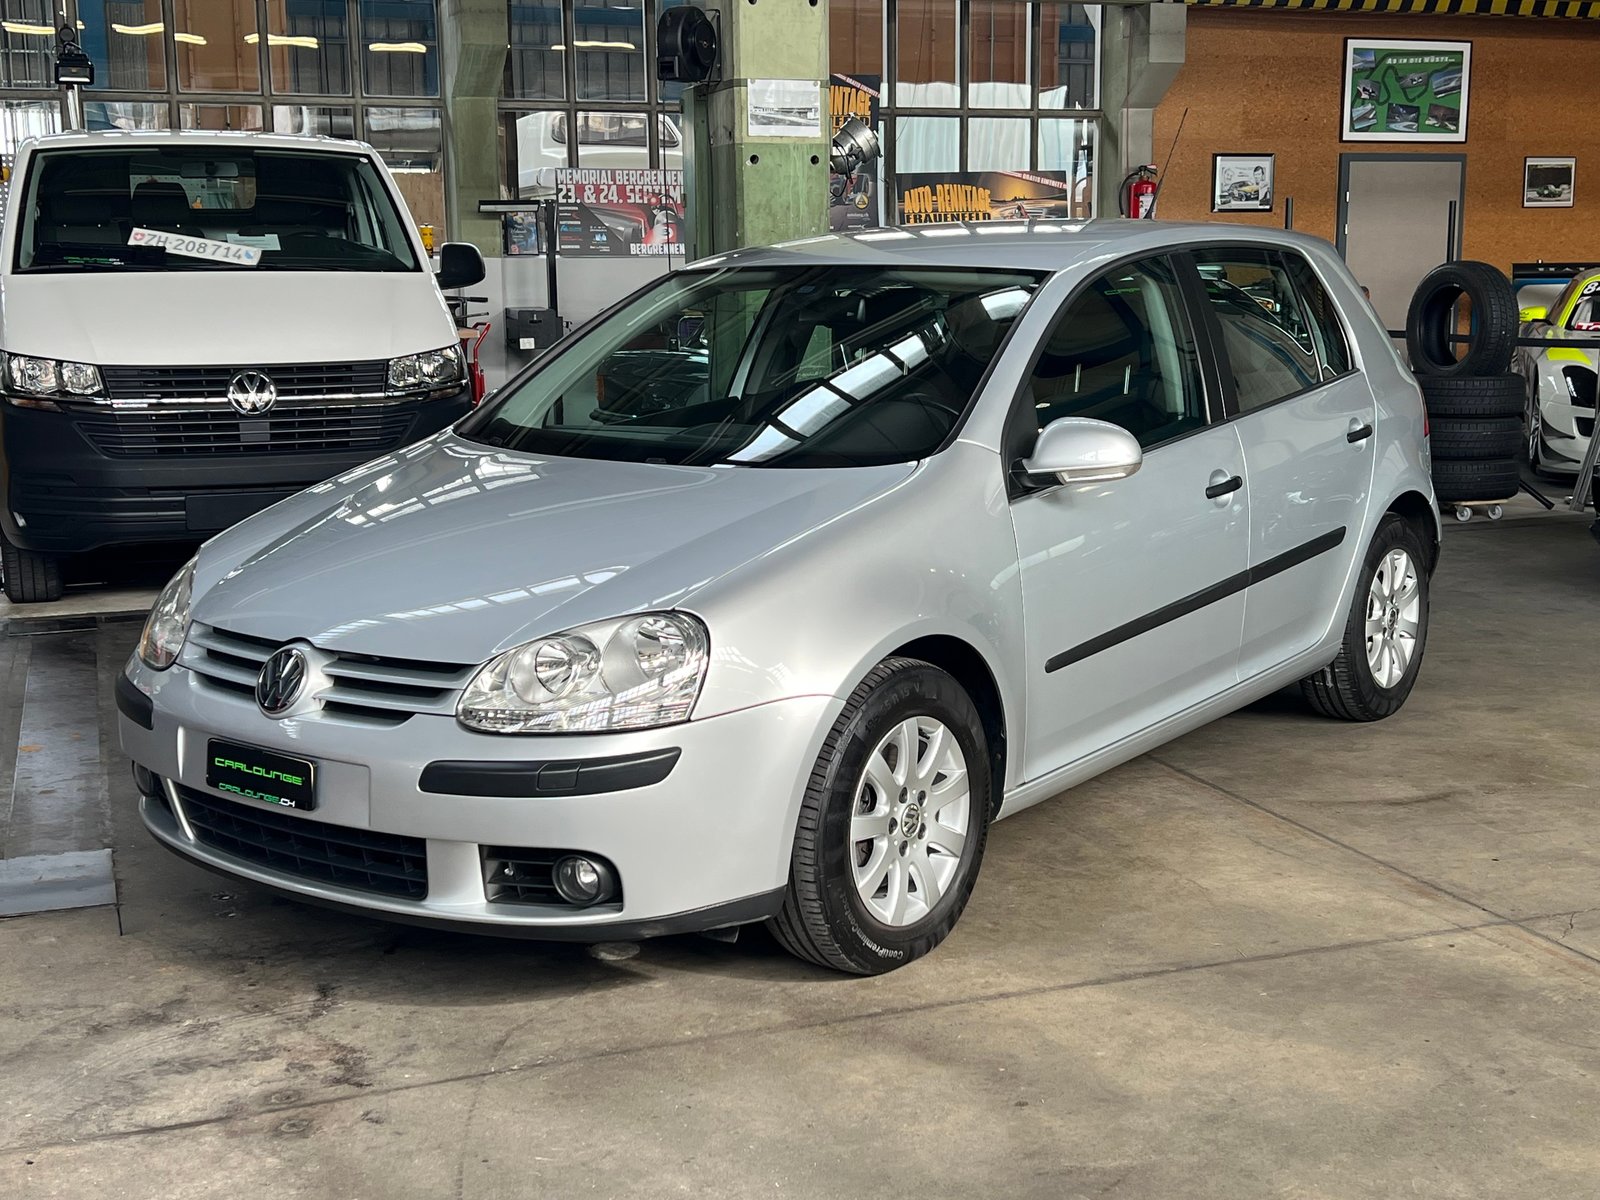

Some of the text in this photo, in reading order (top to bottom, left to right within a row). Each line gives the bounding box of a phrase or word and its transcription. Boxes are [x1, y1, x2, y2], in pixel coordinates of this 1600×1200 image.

[557, 169, 684, 186] MEMORIAL BERGRENNEN
[558, 184, 581, 204] 23.
[584, 185, 597, 204] &
[599, 185, 624, 204] 24.
[904, 183, 992, 214] AUTO-RENNTAGE
[211, 243, 243, 261] 714
[630, 242, 686, 255] BERGRENNEN
[214, 757, 304, 786] CARLOUNGE
